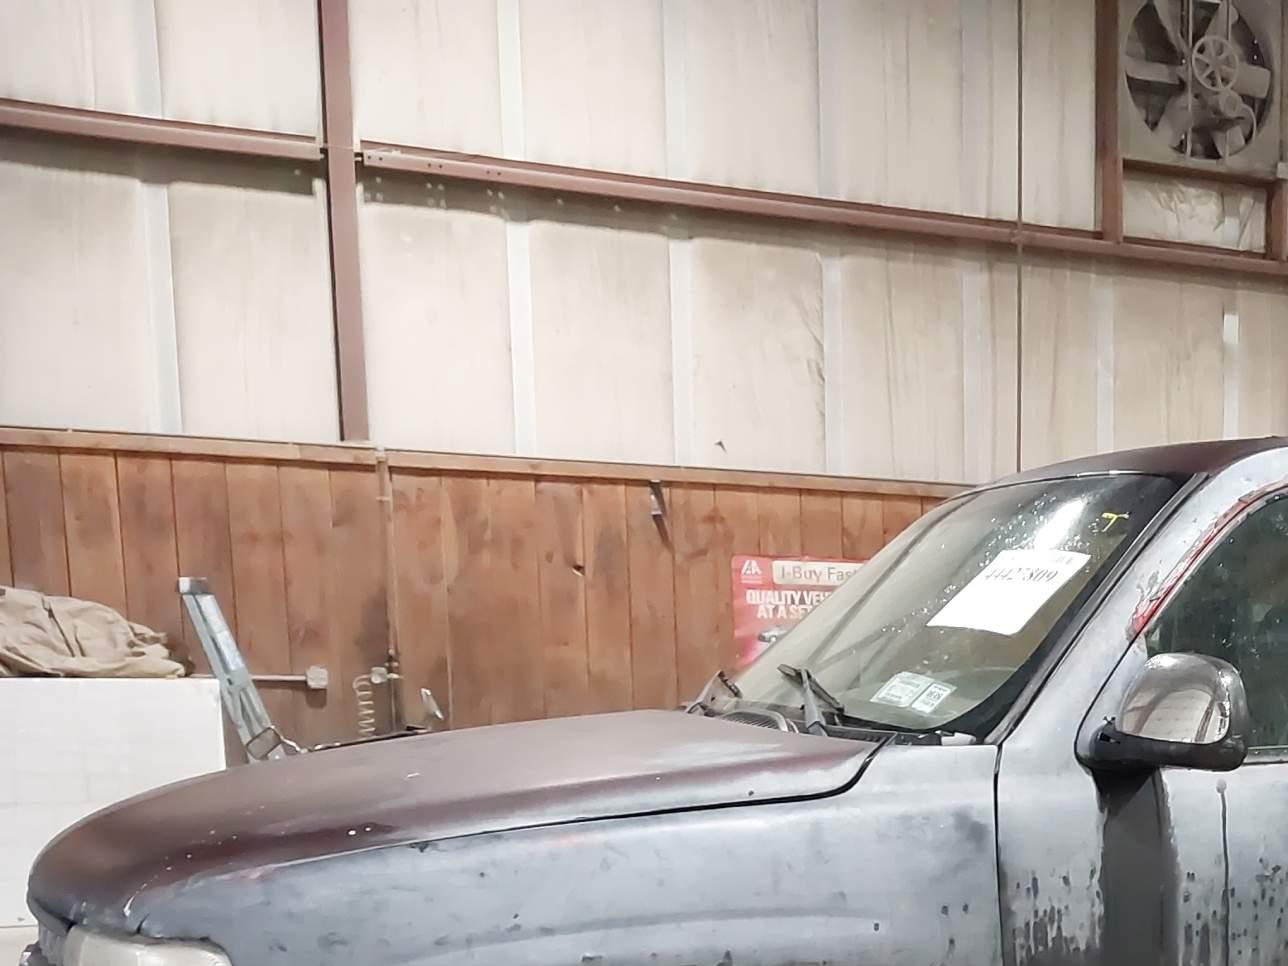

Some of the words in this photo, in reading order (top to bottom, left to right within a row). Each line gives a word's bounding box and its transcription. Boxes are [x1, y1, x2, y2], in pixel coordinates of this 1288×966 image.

[781, 566, 823, 582] I-Buy
[745, 589, 802, 605] QUALITY
[757, 605, 775, 619] AT
[775, 605, 788, 619] A
